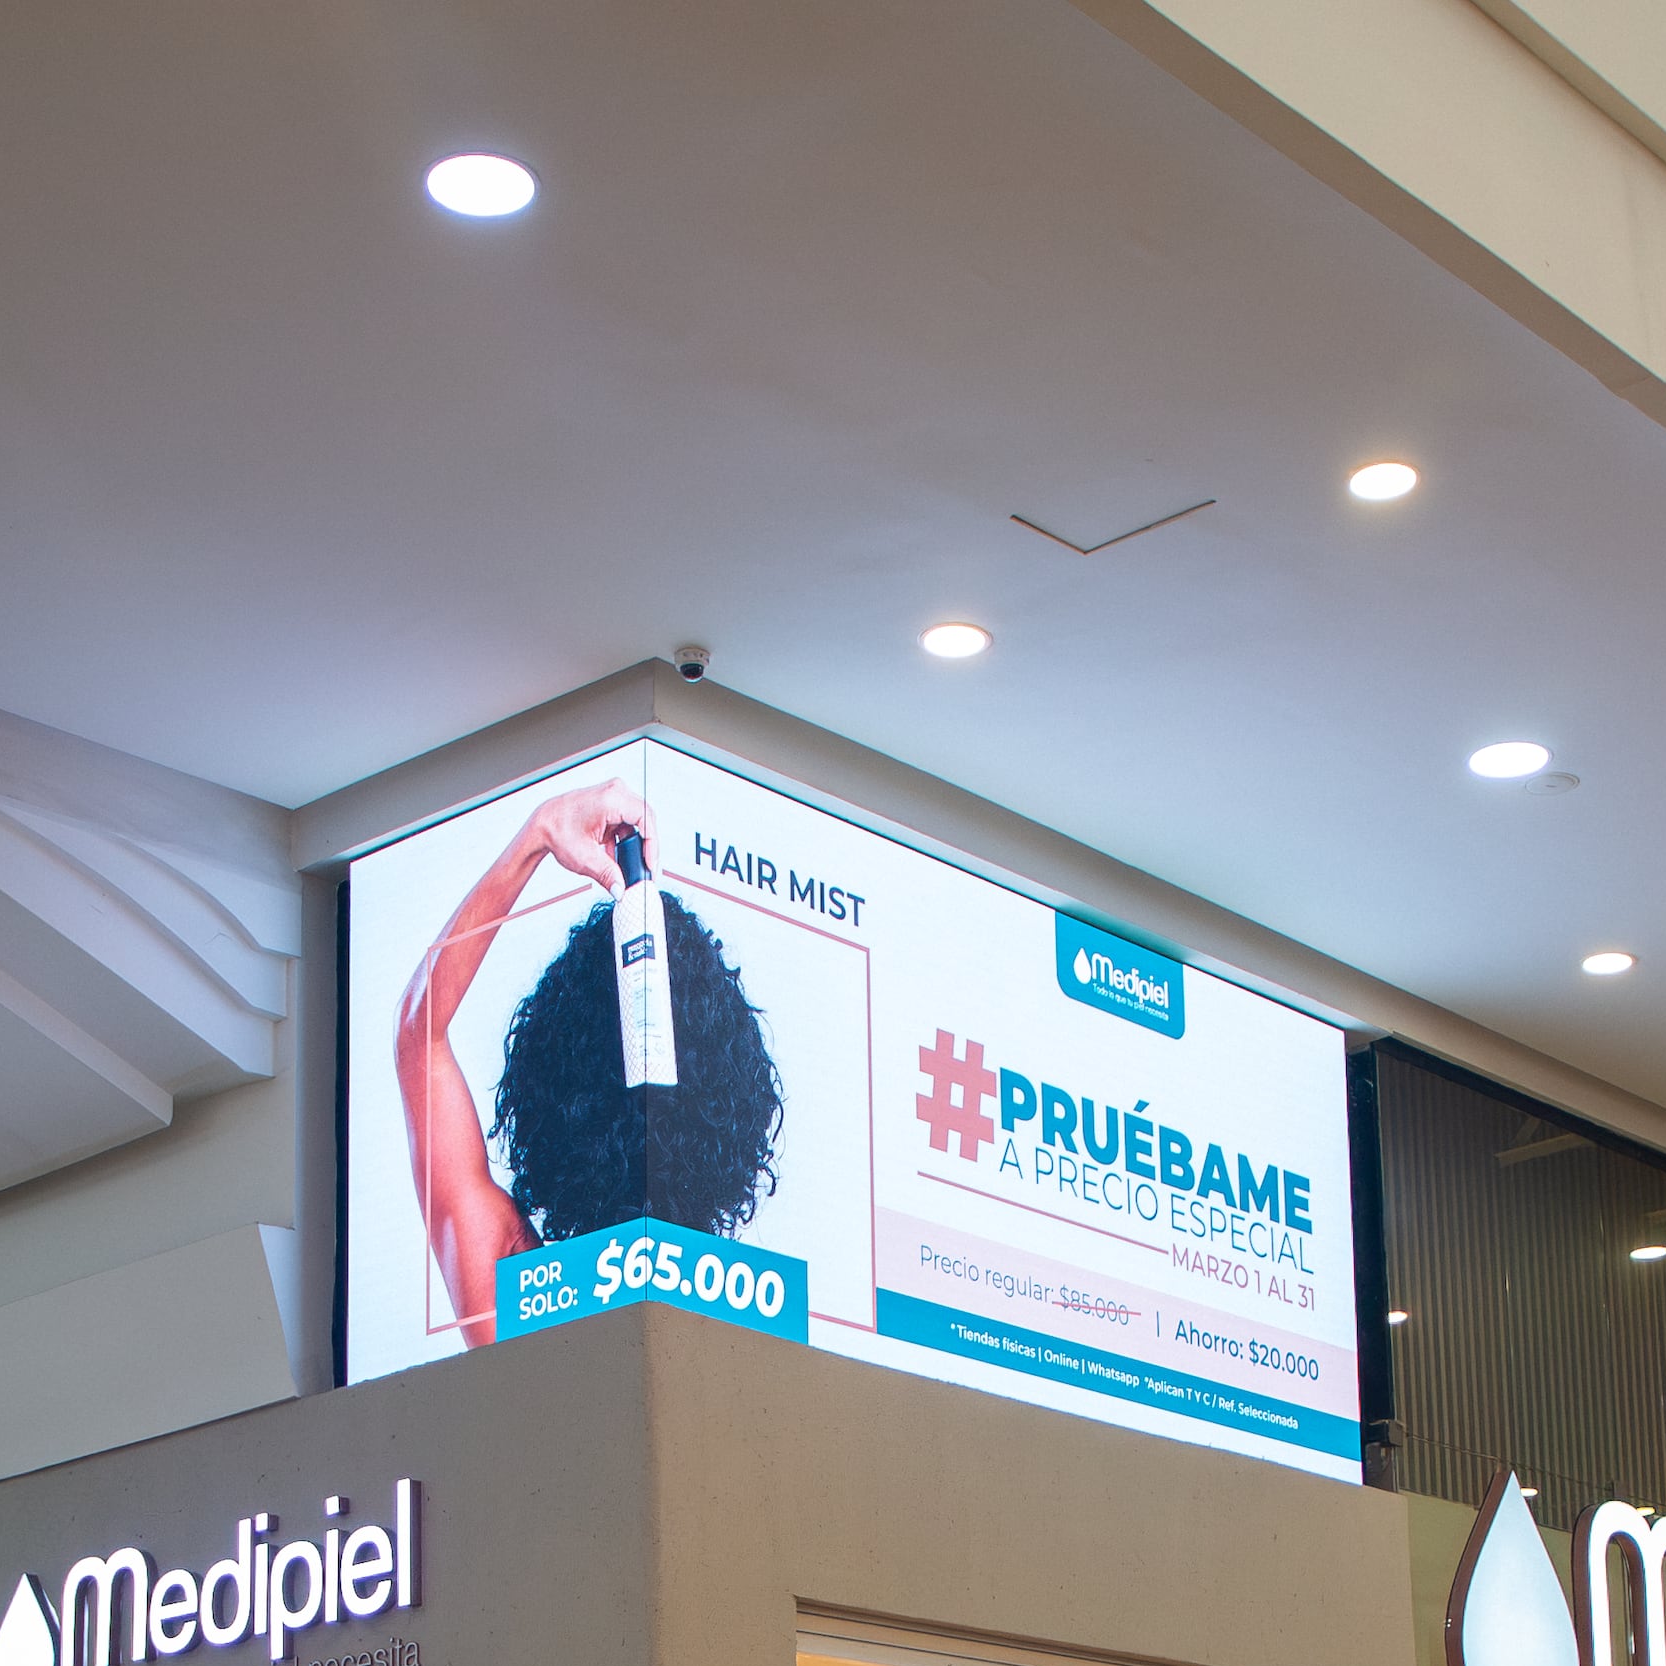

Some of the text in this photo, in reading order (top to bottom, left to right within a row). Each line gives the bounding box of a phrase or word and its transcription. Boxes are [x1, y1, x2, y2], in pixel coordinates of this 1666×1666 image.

[695, 832, 865, 927] HAIR MIST
[1091, 953, 1169, 1009] Medipiel
[999, 1138, 1315, 1275] A PRECIO ESPECIAL
[519, 1261, 563, 1293] POR
[519, 1286, 578, 1320] SOLO:
[592, 1236, 786, 1318] $65.000
[920, 1245, 1131, 1326] Precio regular: $85.000
[1172, 1243, 1315, 1311] MARZO 1 AL 31
[1044, 1348, 1080, 1371] Online
[1087, 1359, 1140, 1388] Whatsapp
[1175, 1319, 1320, 1381] Ahorro: $20.000
[1186, 1386, 1193, 1400] T
[1194, 1389, 1201, 1403] Y
[1202, 1391, 1210, 1405] C
[1218, 1396, 1236, 1415] Ref.
[1238, 1401, 1299, 1430] Seleccionada
